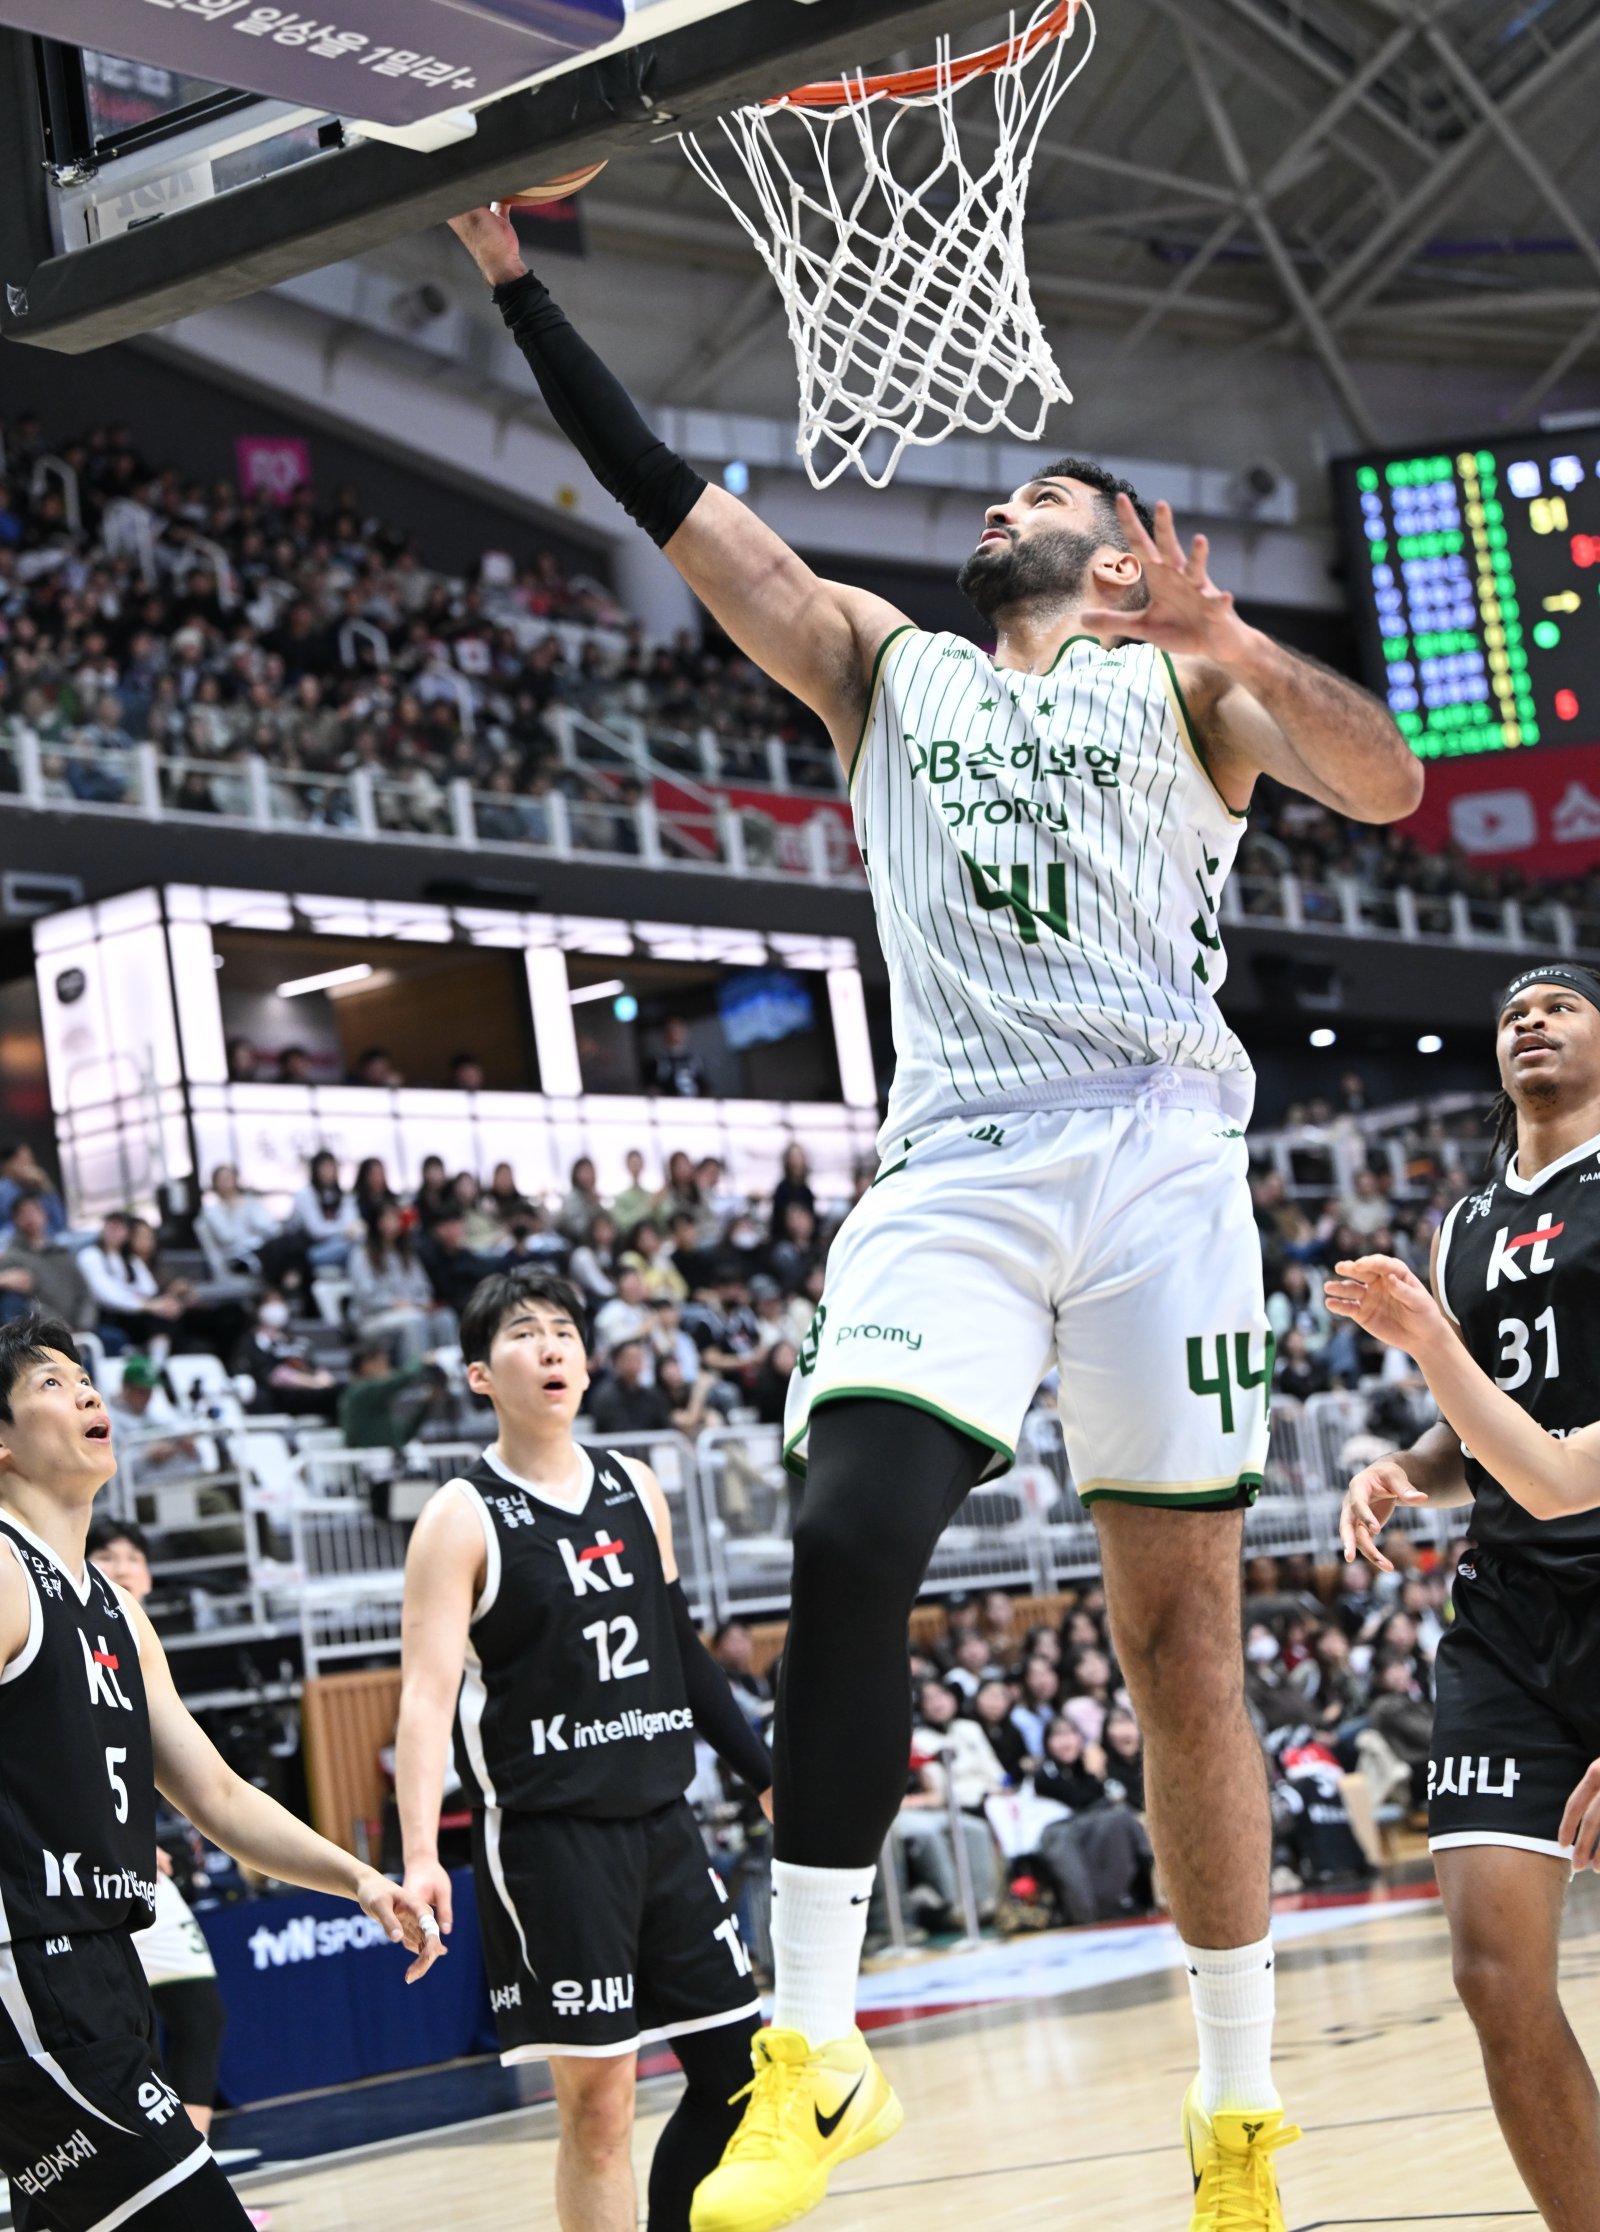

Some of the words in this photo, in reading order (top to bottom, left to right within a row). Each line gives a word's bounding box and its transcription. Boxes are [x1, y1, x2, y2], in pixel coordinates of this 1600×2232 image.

[232, 7, 369, 59] 일상을
[358, 46, 477, 90] 1밀리+
[961, 849, 1069, 945] 44
[1486, 1212, 1565, 1292] kt
[836, 1324, 922, 1351] promy
[1495, 1305, 1560, 1391] 31
[1186, 1330, 1277, 1434] 44
[556, 1530, 635, 1597] kt
[77, 1627, 134, 1711] kt
[582, 1615, 650, 1682] 12
[531, 1713, 570, 1756] K
[574, 1707, 694, 1749] intelligence
[105, 1747, 128, 1825] 5
[42, 1848, 84, 1897] K
[552, 1973, 634, 2016] 유사나
[13, 2128, 98, 2196] 리의서재
